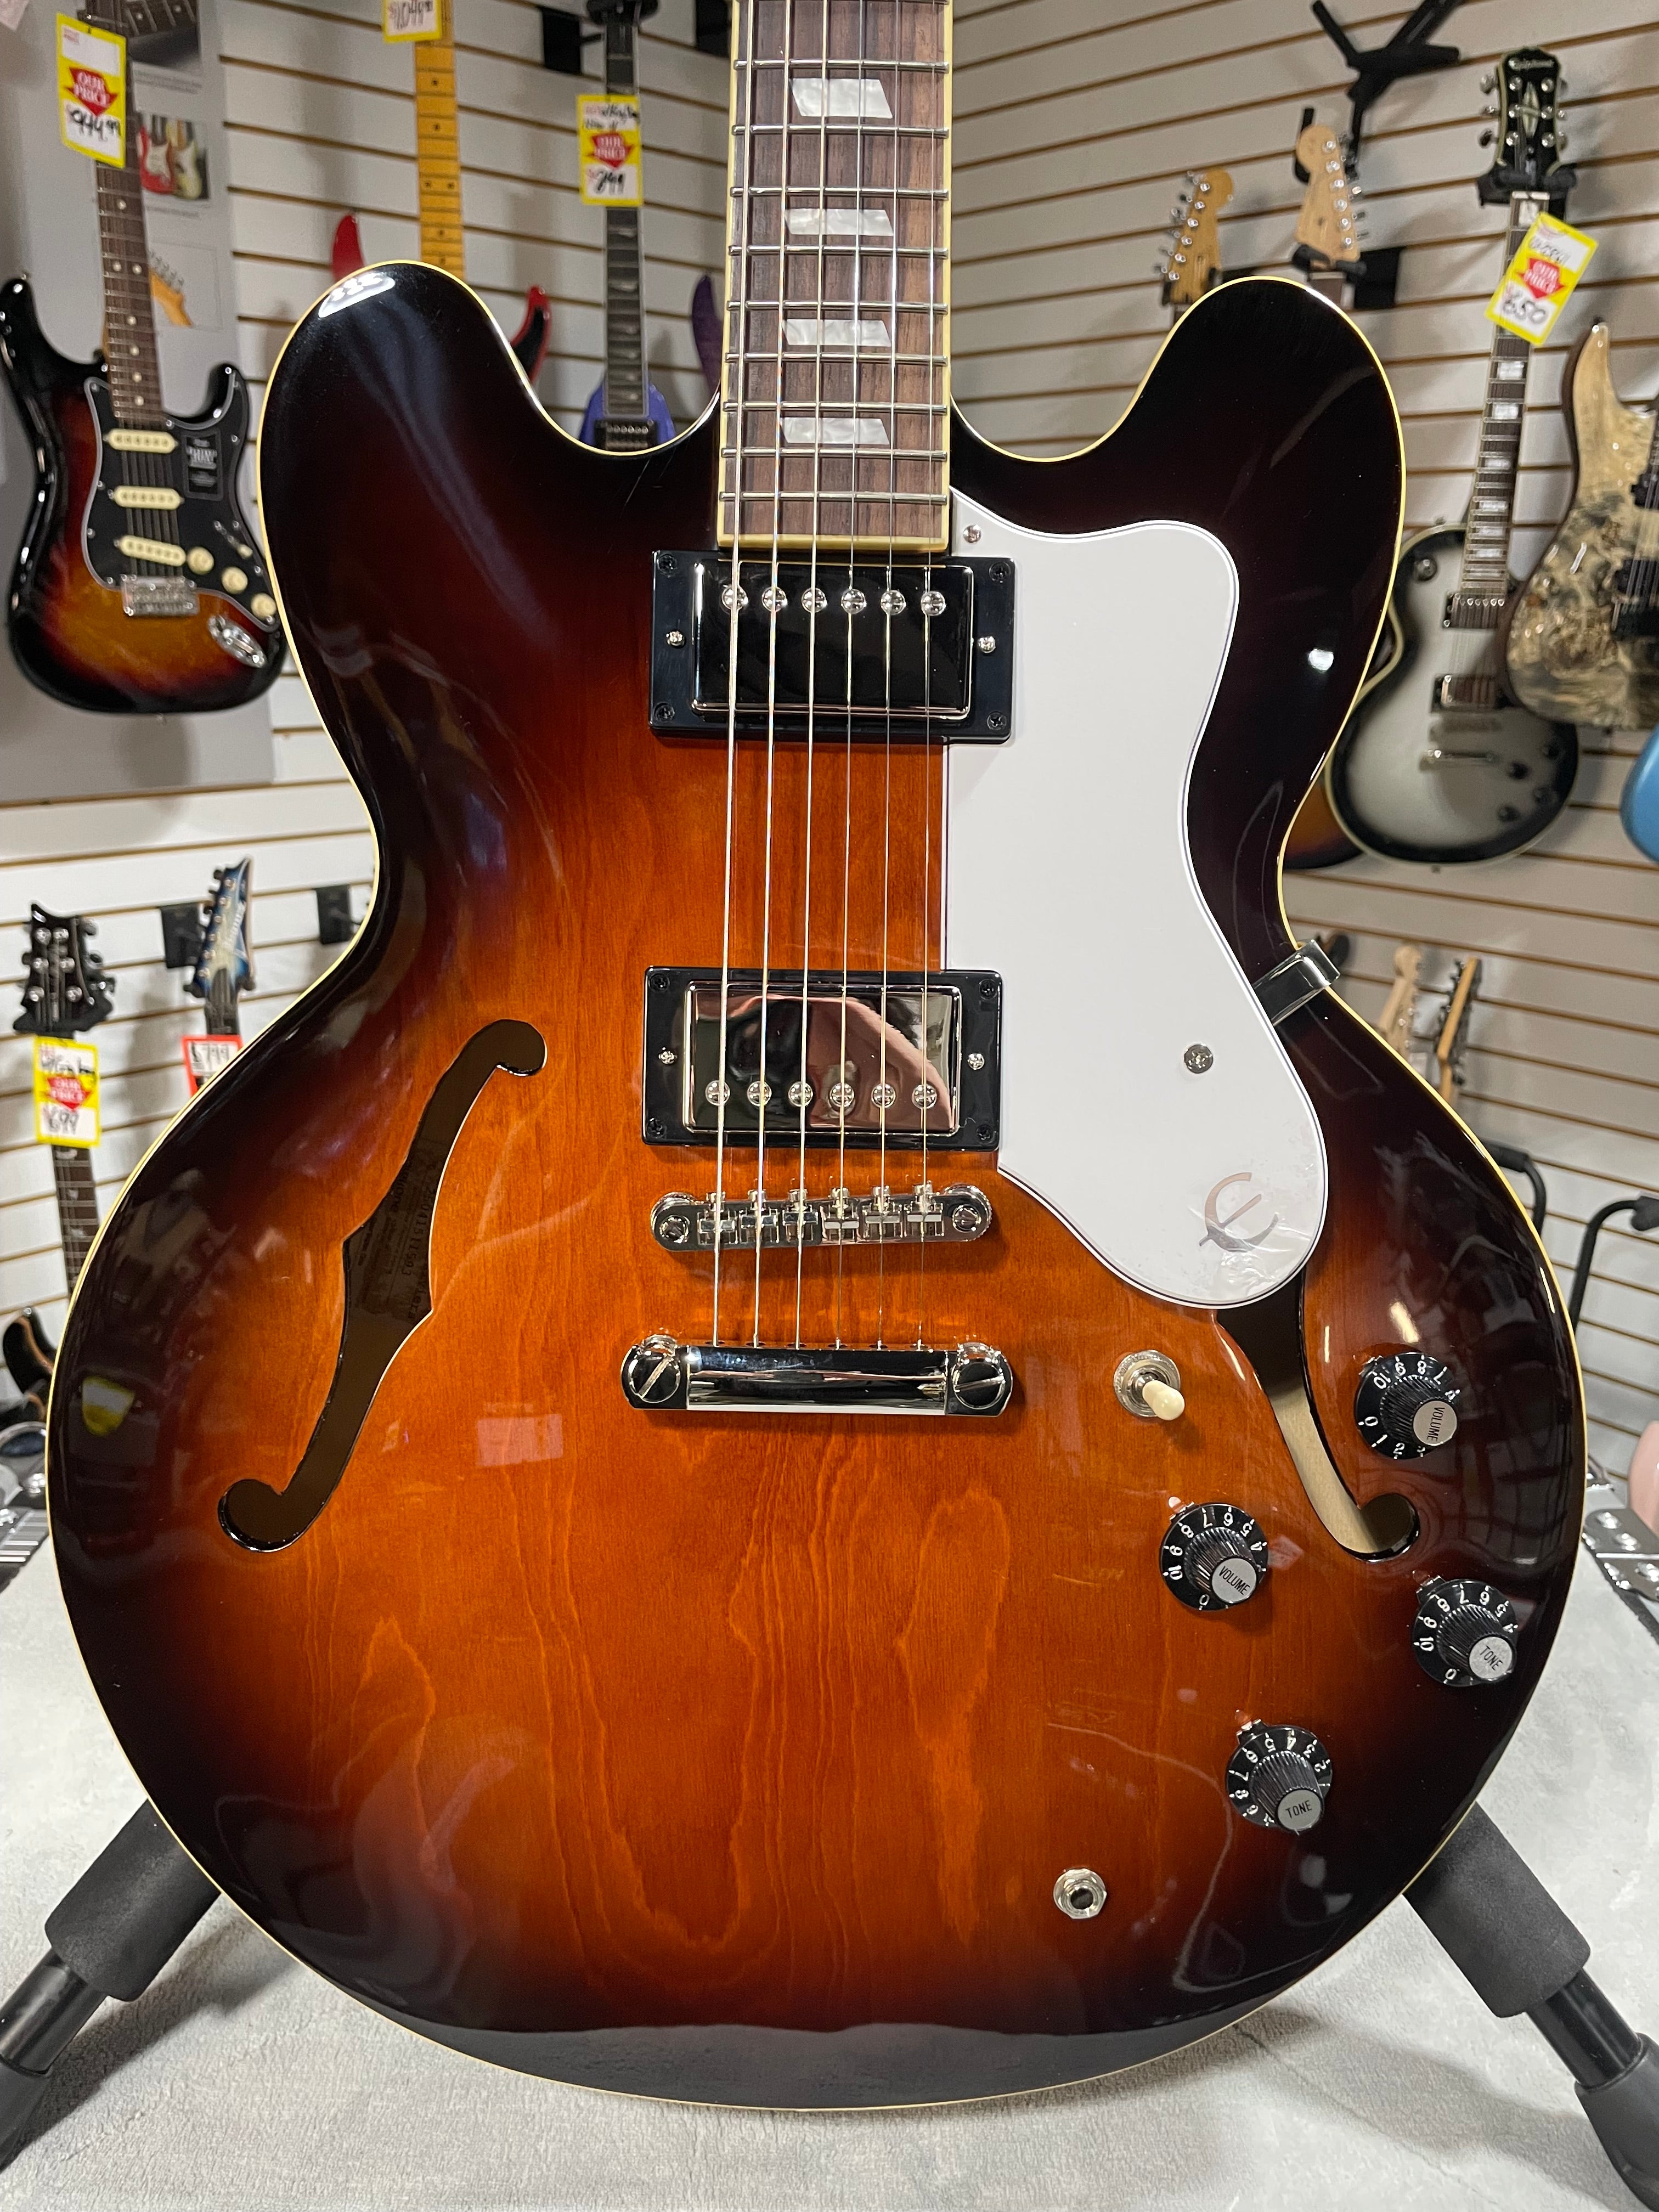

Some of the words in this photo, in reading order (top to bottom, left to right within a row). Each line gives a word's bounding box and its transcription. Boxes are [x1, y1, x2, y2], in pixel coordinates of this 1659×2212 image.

[1417, 1360, 1427, 1375] 8
[1427, 1407, 1446, 1442] VOLUME
[1218, 1565, 1251, 1596] VOLUME
[1479, 1645, 1504, 1672] TONE
[1285, 1800, 1313, 1819] TONE
